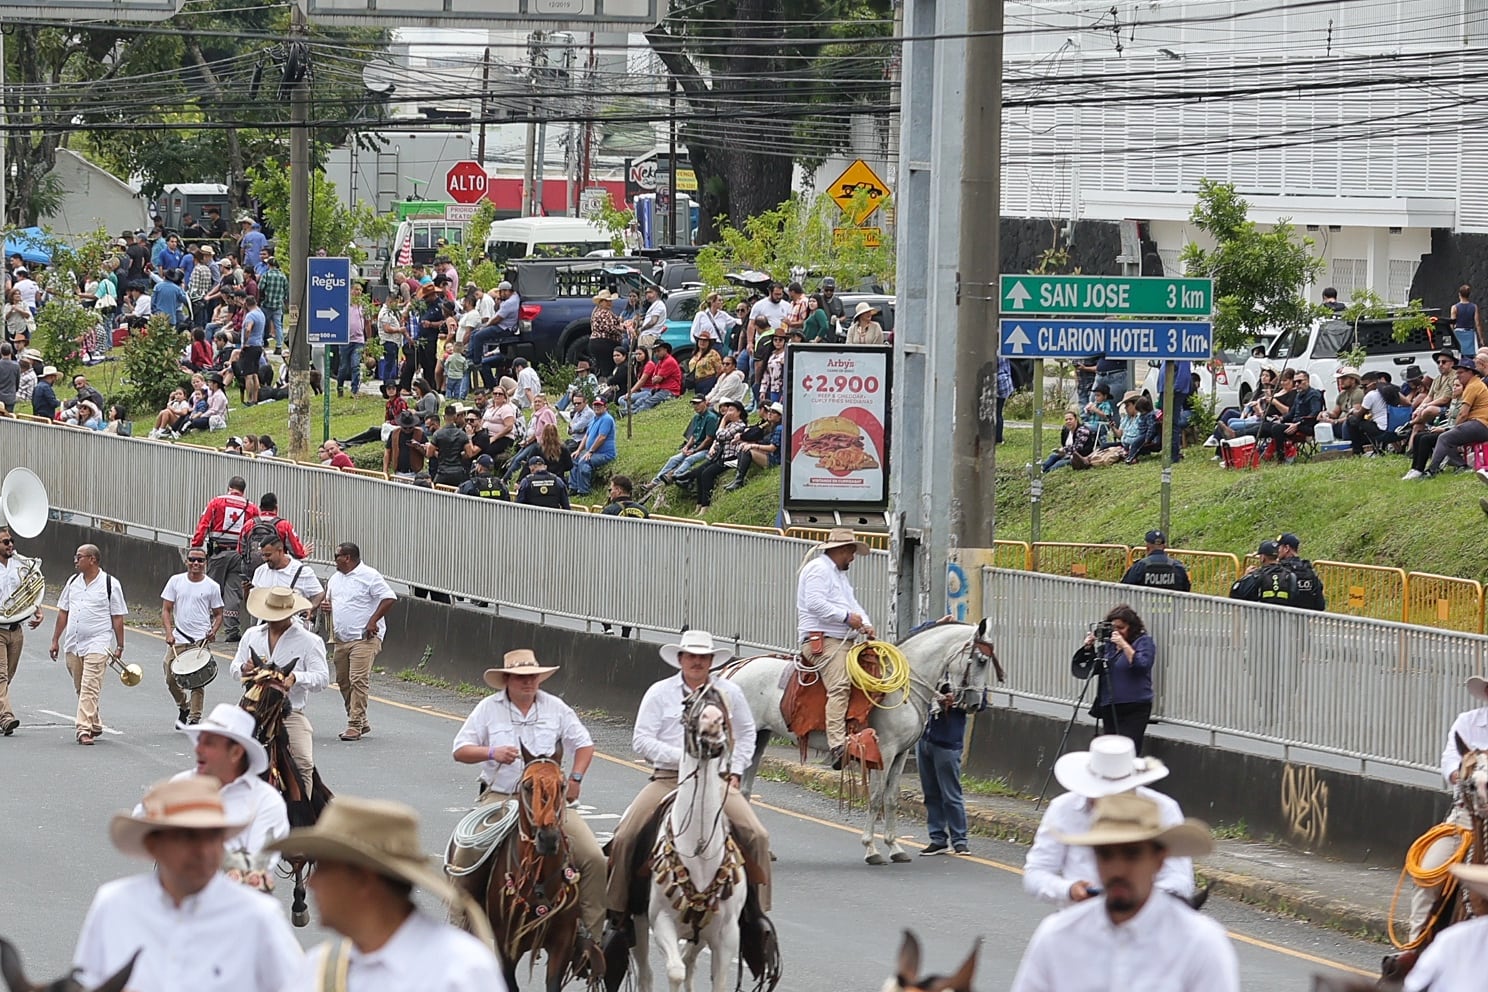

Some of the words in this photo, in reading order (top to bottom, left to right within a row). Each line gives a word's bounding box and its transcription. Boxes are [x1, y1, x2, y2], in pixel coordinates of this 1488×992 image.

[449, 174, 485, 191] ALTO
[311, 275, 346, 291] Regus
[1040, 283, 1078, 308] SAN
[1083, 284, 1130, 309] JOSE
[1166, 284, 1177, 309] 3
[1181, 285, 1205, 309] km
[1037, 327, 1105, 352] CLARION
[1110, 328, 1158, 352] HOTEL
[1167, 329, 1178, 353] 3
[1182, 329, 1205, 353] km
[827, 359, 855, 370] Arby's
[1144, 572, 1176, 585] POLICIA
